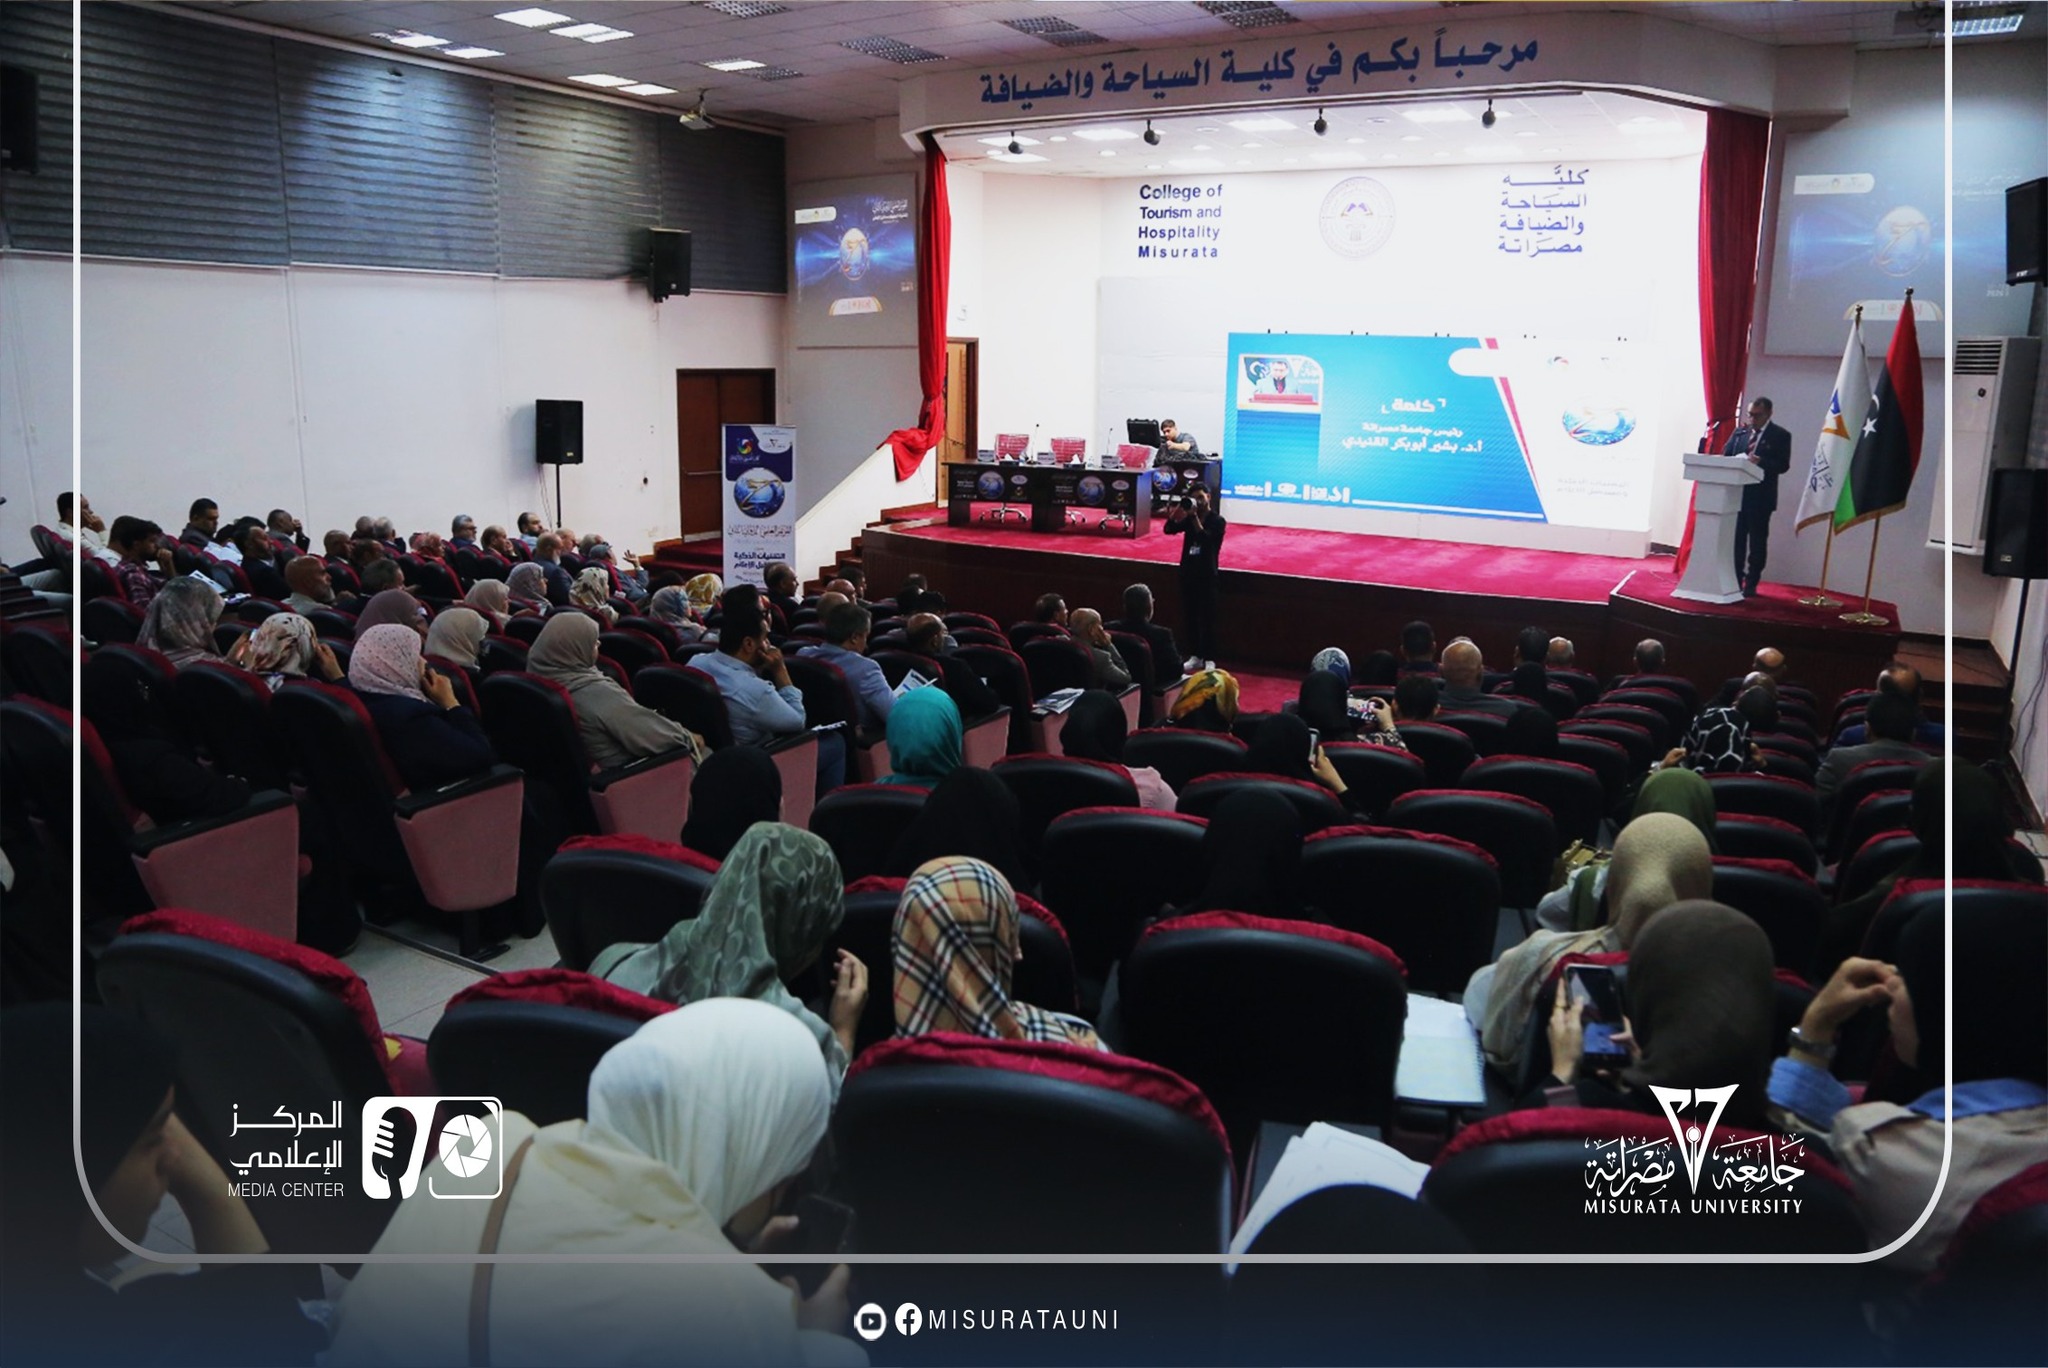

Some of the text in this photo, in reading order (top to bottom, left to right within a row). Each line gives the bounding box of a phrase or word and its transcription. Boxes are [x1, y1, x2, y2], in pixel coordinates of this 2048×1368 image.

[1220, 47, 1296, 93] كلية
[1305, 41, 1342, 93] في
[1353, 37, 1420, 84] بكم
[980, 68, 1095, 110] والضيافة
[1102, 57, 1211, 99] السياحة
[1139, 183, 1223, 202] College of
[1139, 205, 1222, 219] Tourism and
[1500, 214, 1584, 235] والضيافة
[1138, 225, 1220, 241] Hospitality
[1138, 245, 1218, 258] Misurata
